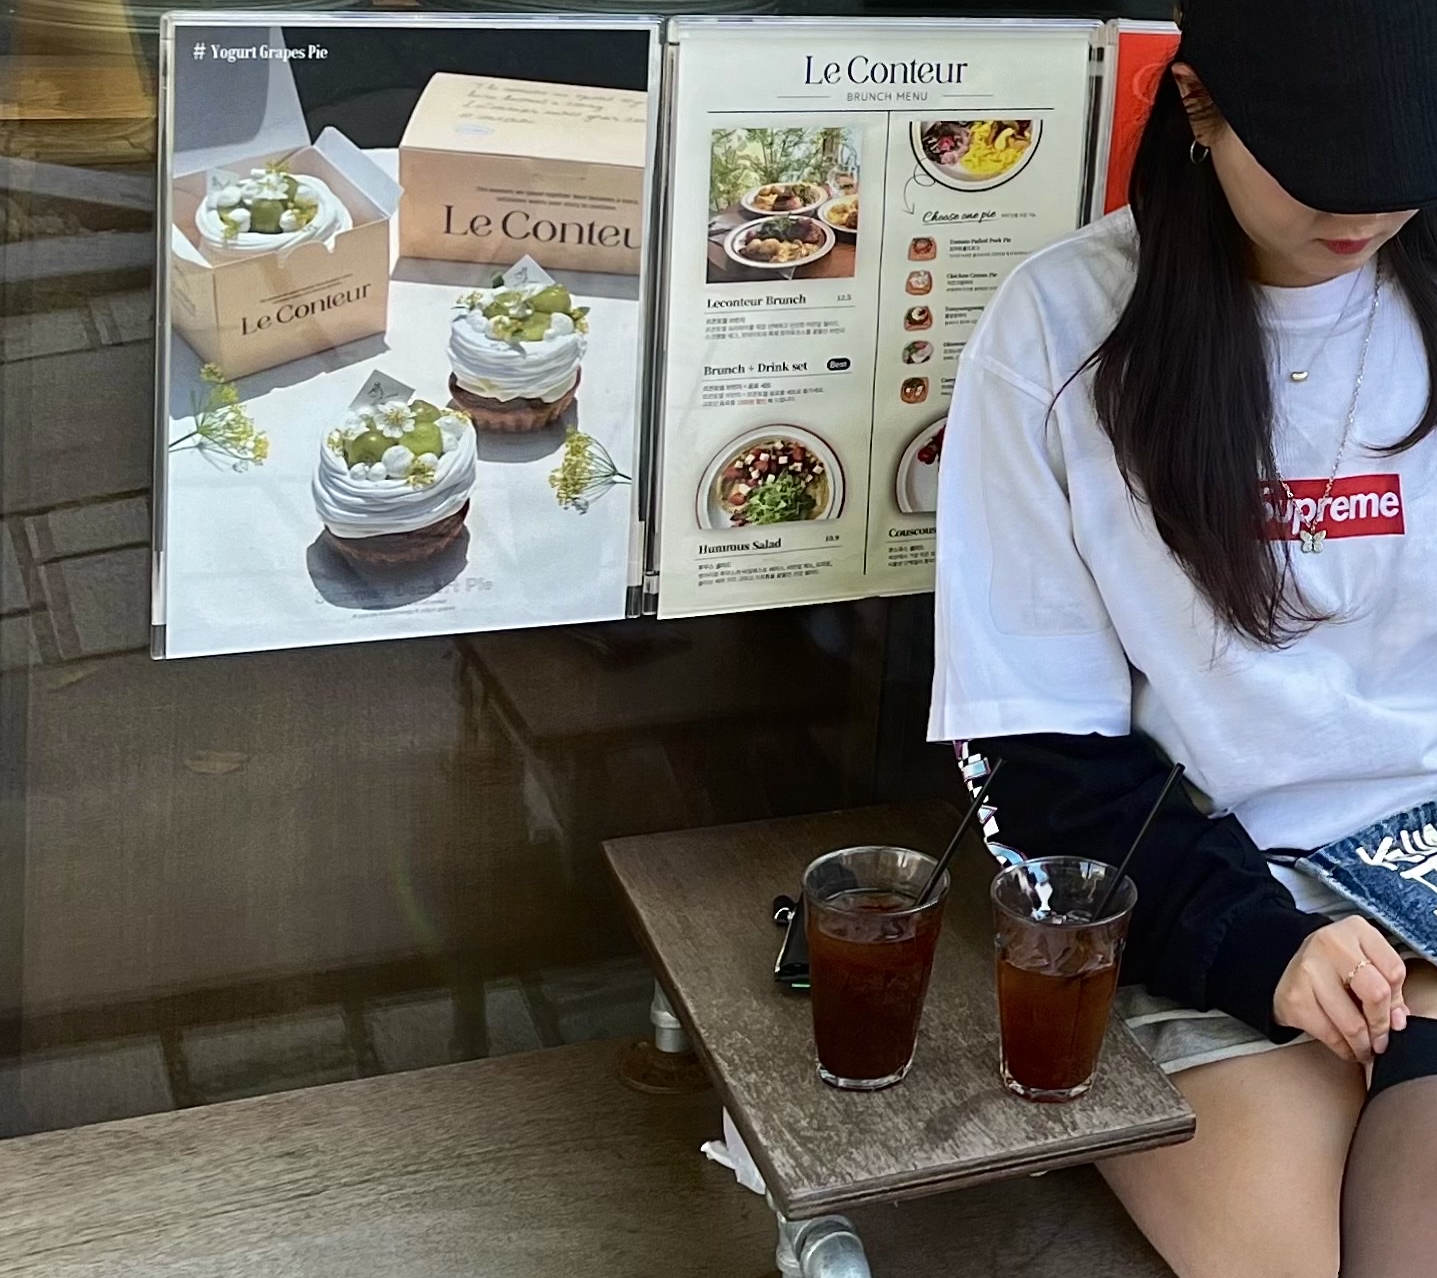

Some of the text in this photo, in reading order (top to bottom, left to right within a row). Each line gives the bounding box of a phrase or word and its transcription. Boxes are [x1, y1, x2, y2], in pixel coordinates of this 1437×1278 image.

[211, 44, 257, 63] Yogurt
[259, 44, 306, 62] Grapes
[308, 44, 329, 59] Pie
[805, 55, 968, 84] Le Conteur
[847, 91, 928, 102] BRUNCH MENU
[443, 205, 493, 237] Le
[922, 211, 959, 223] Choose
[978, 210, 997, 223] pie
[706, 297, 763, 309] Leconteur
[766, 293, 806, 306] Brunch
[241, 316, 272, 336] Le
[276, 283, 372, 324] Conteur
[704, 364, 745, 376] Brunch
[757, 361, 789, 373] Drink
[791, 361, 808, 371] set
[829, 361, 848, 369] Best
[699, 543, 750, 554] Hummus
[752, 538, 782, 549] Salad
